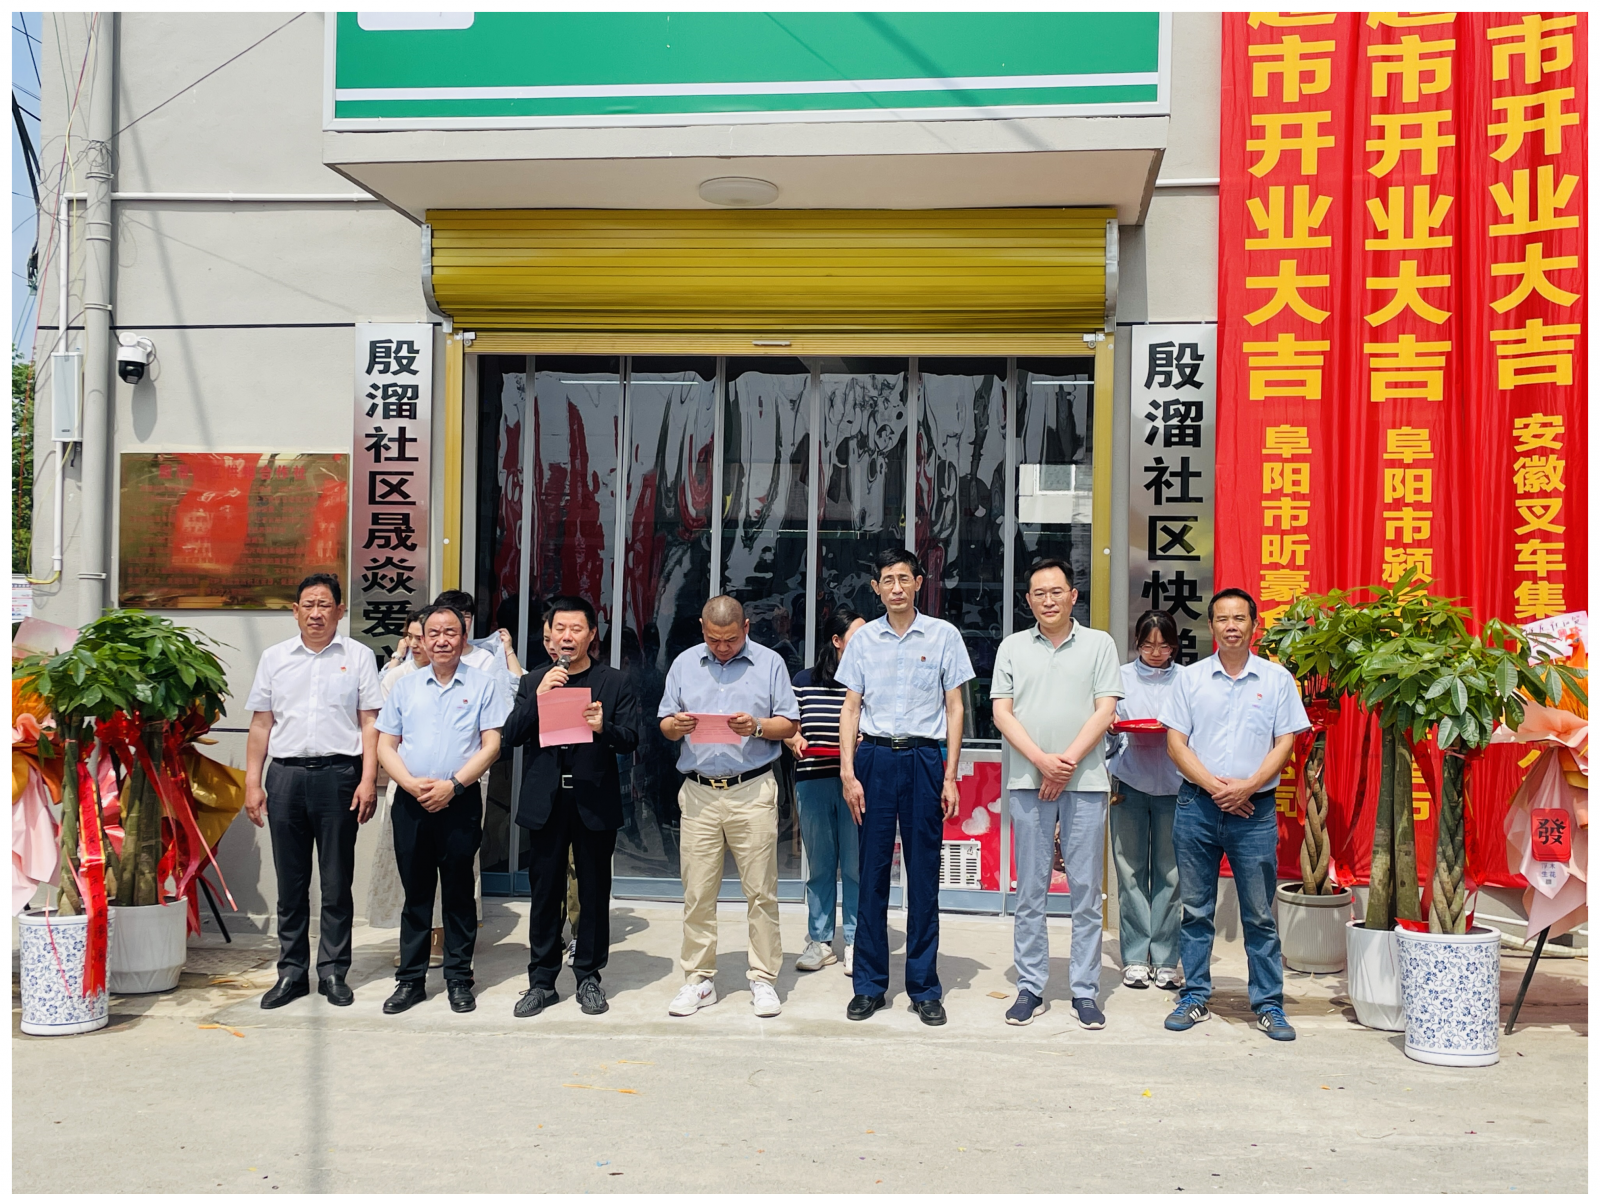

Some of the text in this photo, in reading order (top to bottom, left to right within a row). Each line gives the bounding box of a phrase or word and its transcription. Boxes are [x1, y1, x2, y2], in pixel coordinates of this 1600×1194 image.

[1242, 12, 1337, 401] 市开业大吉
[1363, 12, 1458, 402] 市开业大吉
[1486, 14, 1582, 391] 市开业大吉
[1537, 818, 1567, 846] 發
